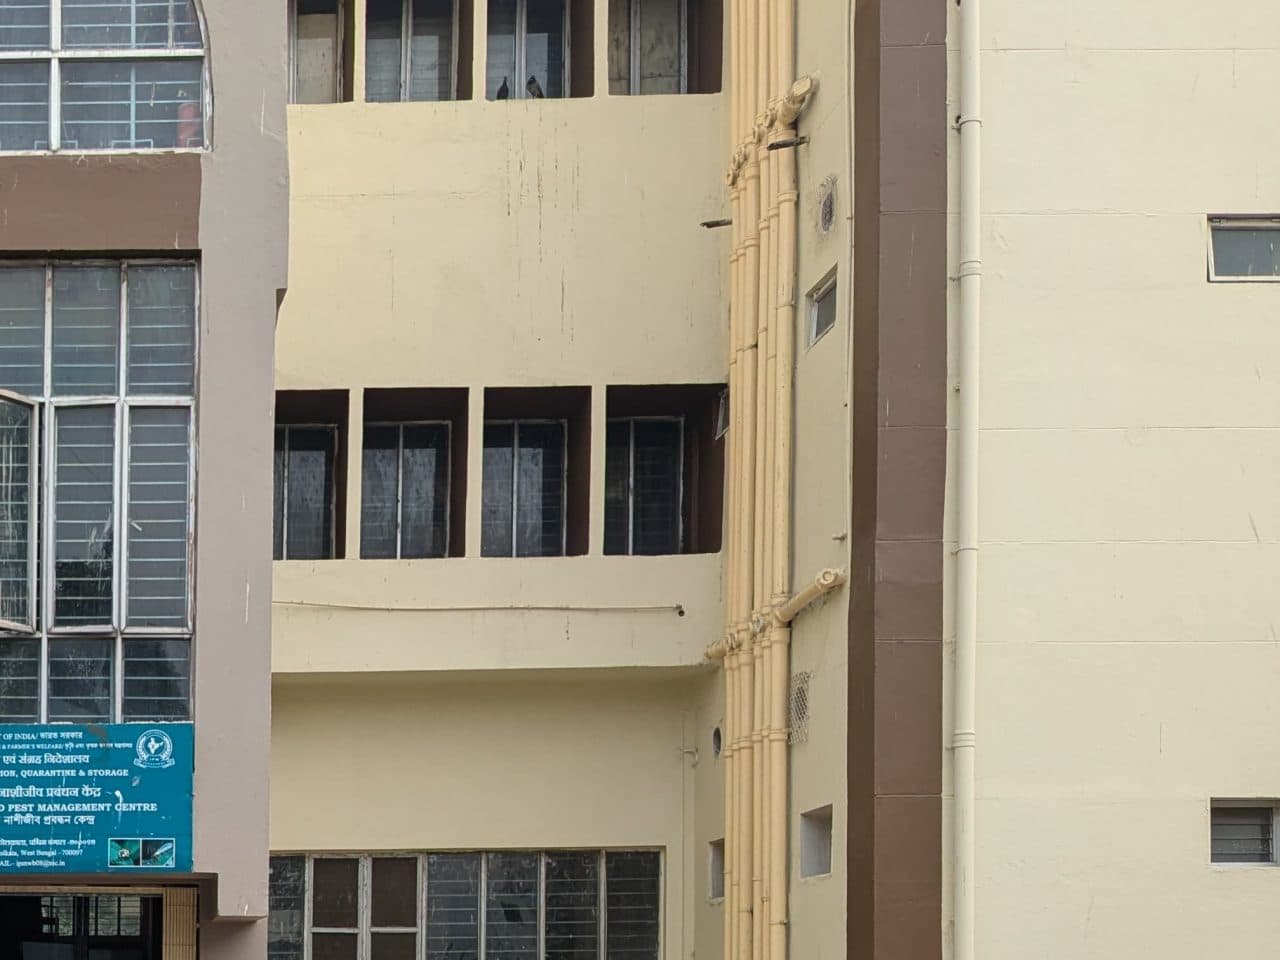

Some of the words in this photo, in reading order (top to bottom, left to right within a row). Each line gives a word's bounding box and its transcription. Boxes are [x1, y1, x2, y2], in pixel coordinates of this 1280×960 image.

[3, 752, 16, 765] एवं
[44, 752, 89, 764] निदेशालय
[21, 769, 76, 778] QUARANTINE
[78, 769, 86, 777] &
[88, 769, 128, 777] STORAGE
[8, 803, 34, 812] PEST
[37, 803, 112, 812] MANAGEMENT
[115, 802, 158, 811] CENTRE
[36, 849, 57, 857] Bengal
